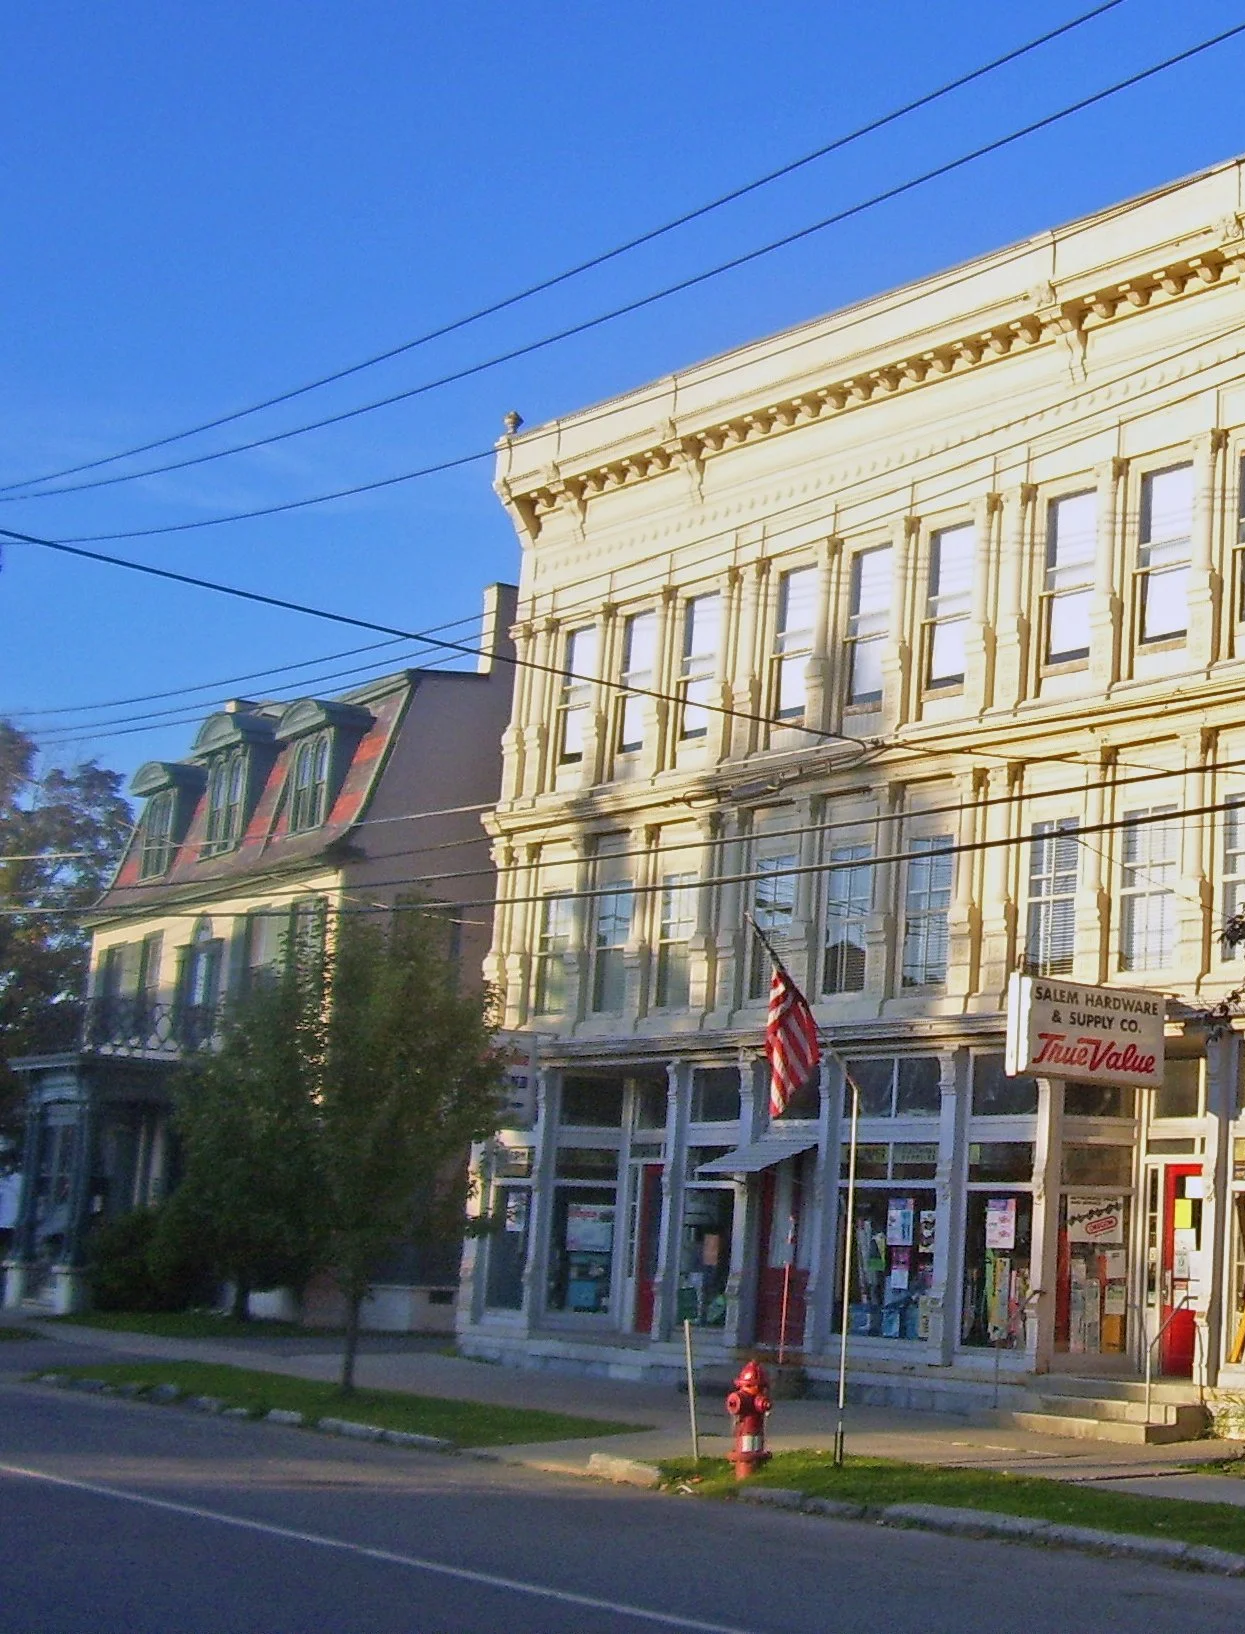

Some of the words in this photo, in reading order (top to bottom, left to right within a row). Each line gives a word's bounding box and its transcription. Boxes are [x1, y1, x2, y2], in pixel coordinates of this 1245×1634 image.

[1035, 986, 1079, 1005] SALEM
[1085, 993, 1159, 1016] HARDWARE
[1051, 1010, 1062, 1024] &
[1069, 1011, 1115, 1030] SUPPLY
[1120, 1018, 1142, 1034] CO.
